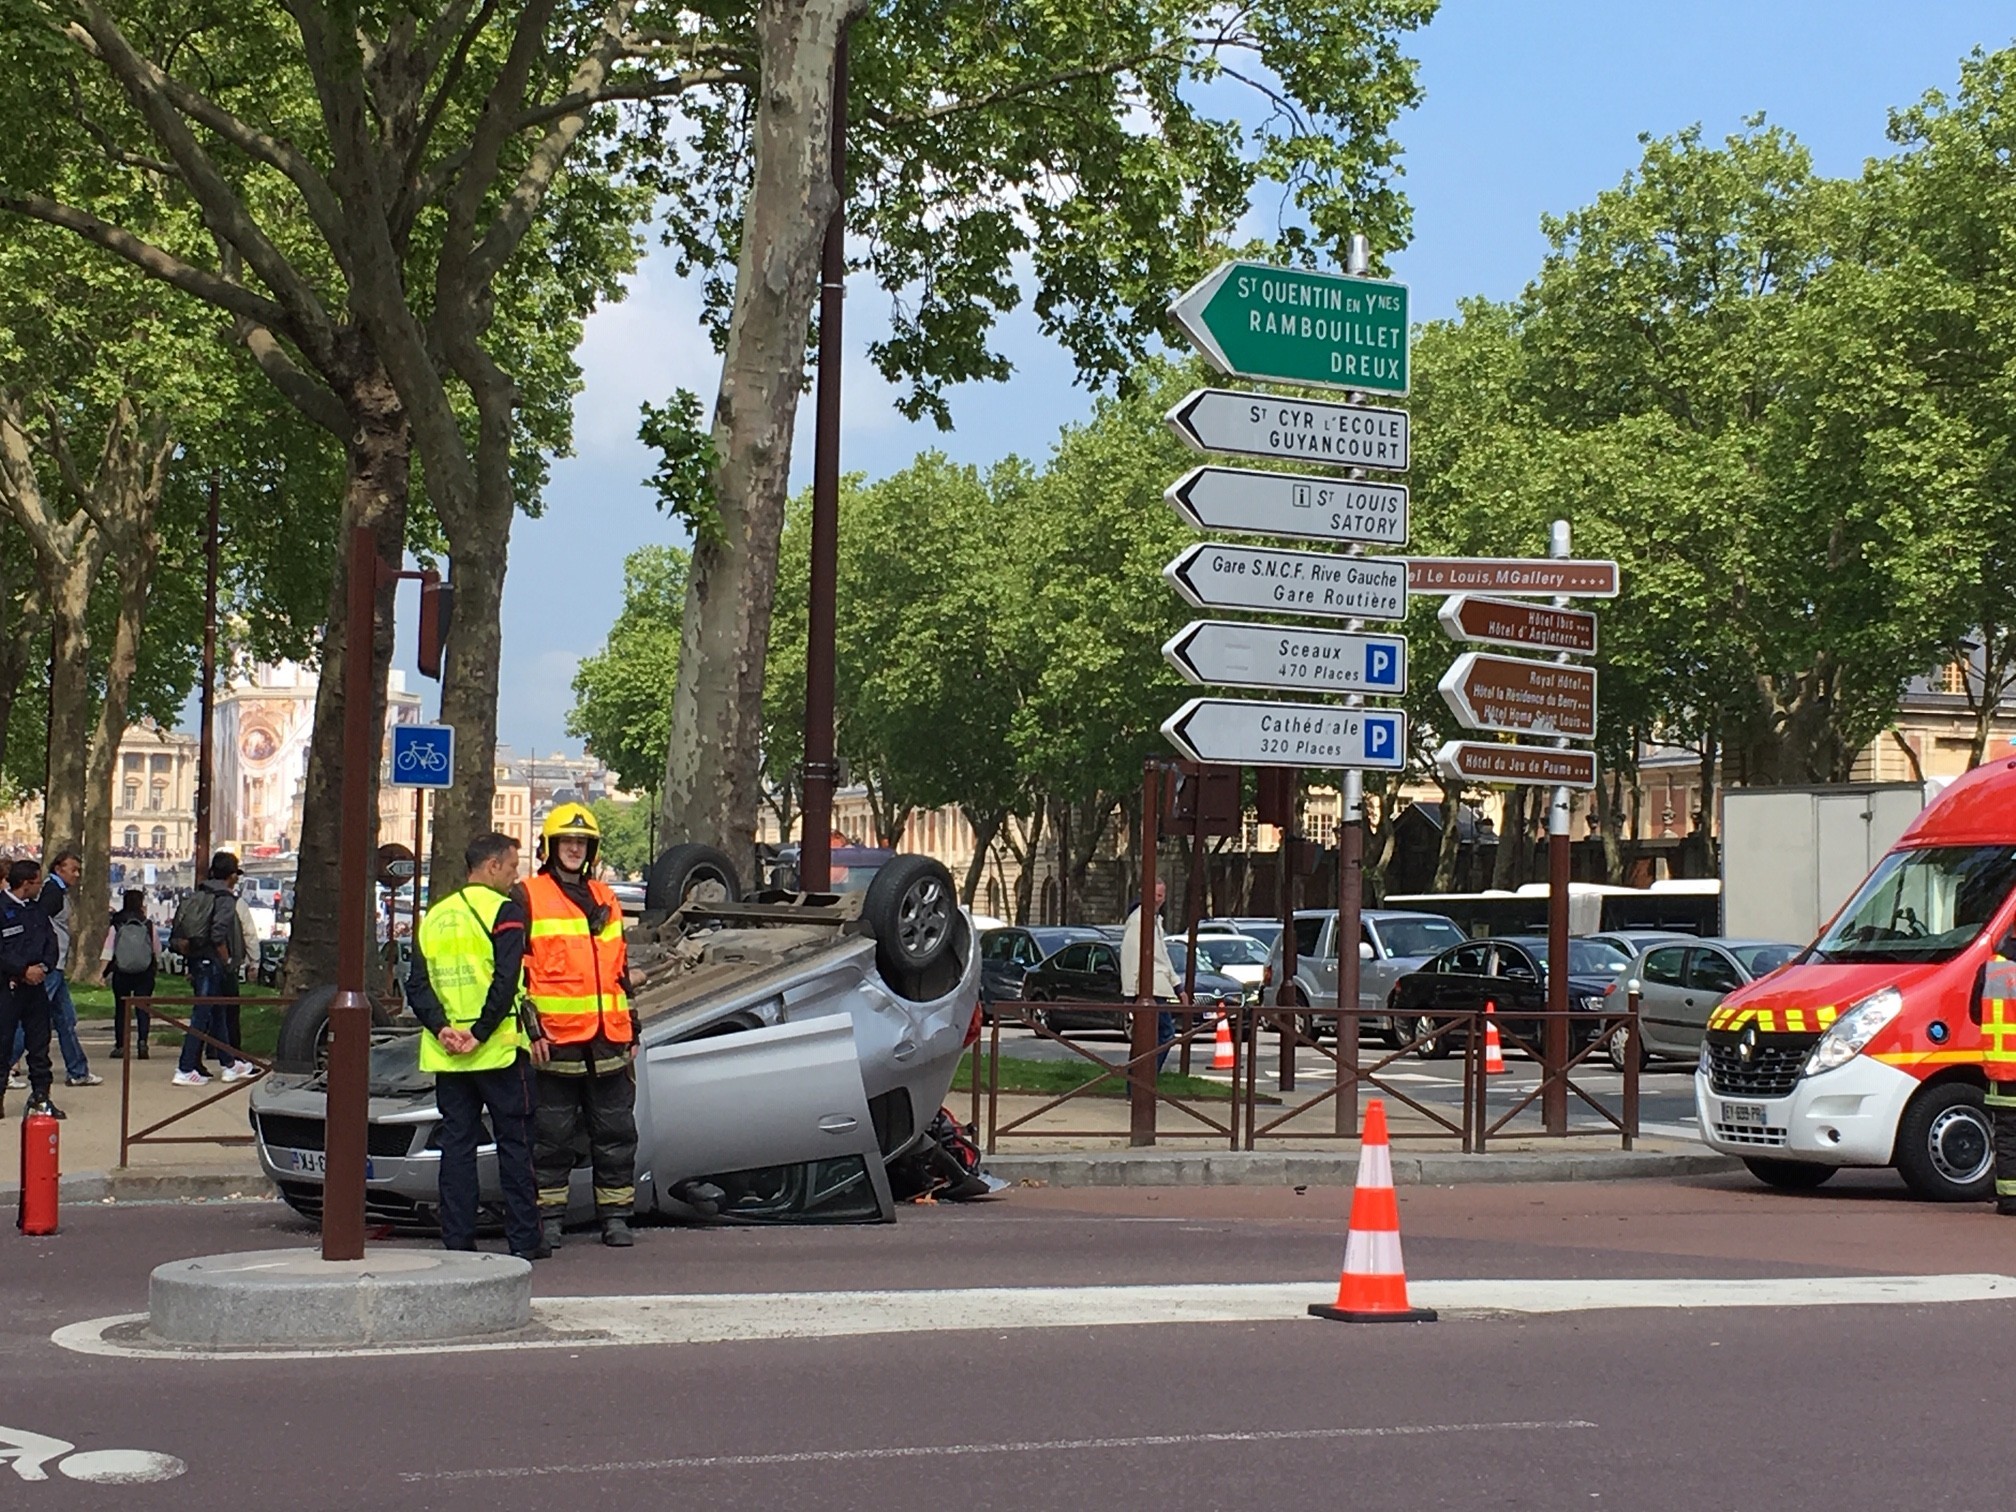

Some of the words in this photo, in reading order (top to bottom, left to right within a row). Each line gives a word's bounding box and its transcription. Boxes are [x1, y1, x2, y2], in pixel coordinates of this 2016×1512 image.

[1262, 280, 1341, 311] QUENTIN
[1346, 298, 1360, 313] EN
[1250, 310, 1399, 349] RAMBOUILLET
[1331, 352, 1399, 380] DREUX
[1279, 409, 1313, 429] CYR
[1270, 430, 1398, 460] GUYANCOURT
[1346, 492, 1398, 513] LOUIS
[1330, 513, 1398, 535] SATORY
[1212, 556, 1246, 574] Gare
[1311, 565, 1341, 583] Rive
[1347, 567, 1397, 588] Gauche
[1427, 570, 1444, 583] Le
[1450, 570, 1493, 586] Louis,
[1495, 570, 1565, 587] MGallery
[1273, 584, 1314, 604] Gare
[1324, 588, 1397, 609] Routière
[1488, 621, 1514, 636] Hôtel
[1528, 612, 1553, 627] Hôtel
[1279, 639, 1342, 660] Sceaux
[1278, 663, 1308, 678] 470
[1314, 665, 1359, 681] Places
[1373, 650, 1389, 678] P
[1473, 684, 1495, 698] Hôtel
[1529, 671, 1555, 688] Royal
[1557, 674, 1581, 690] Hôtel
[1261, 715, 1358, 735] Cathédale
[1260, 739, 1289, 753] 320
[1296, 740, 1341, 756] Places
[1372, 725, 1388, 752] P
[1466, 754, 1491, 769] Hôtel
[1494, 757, 1506, 770] du
[1509, 758, 1525, 772] Jeu
[1528, 760, 1540, 773] de
[1542, 760, 1571, 776] Paume
